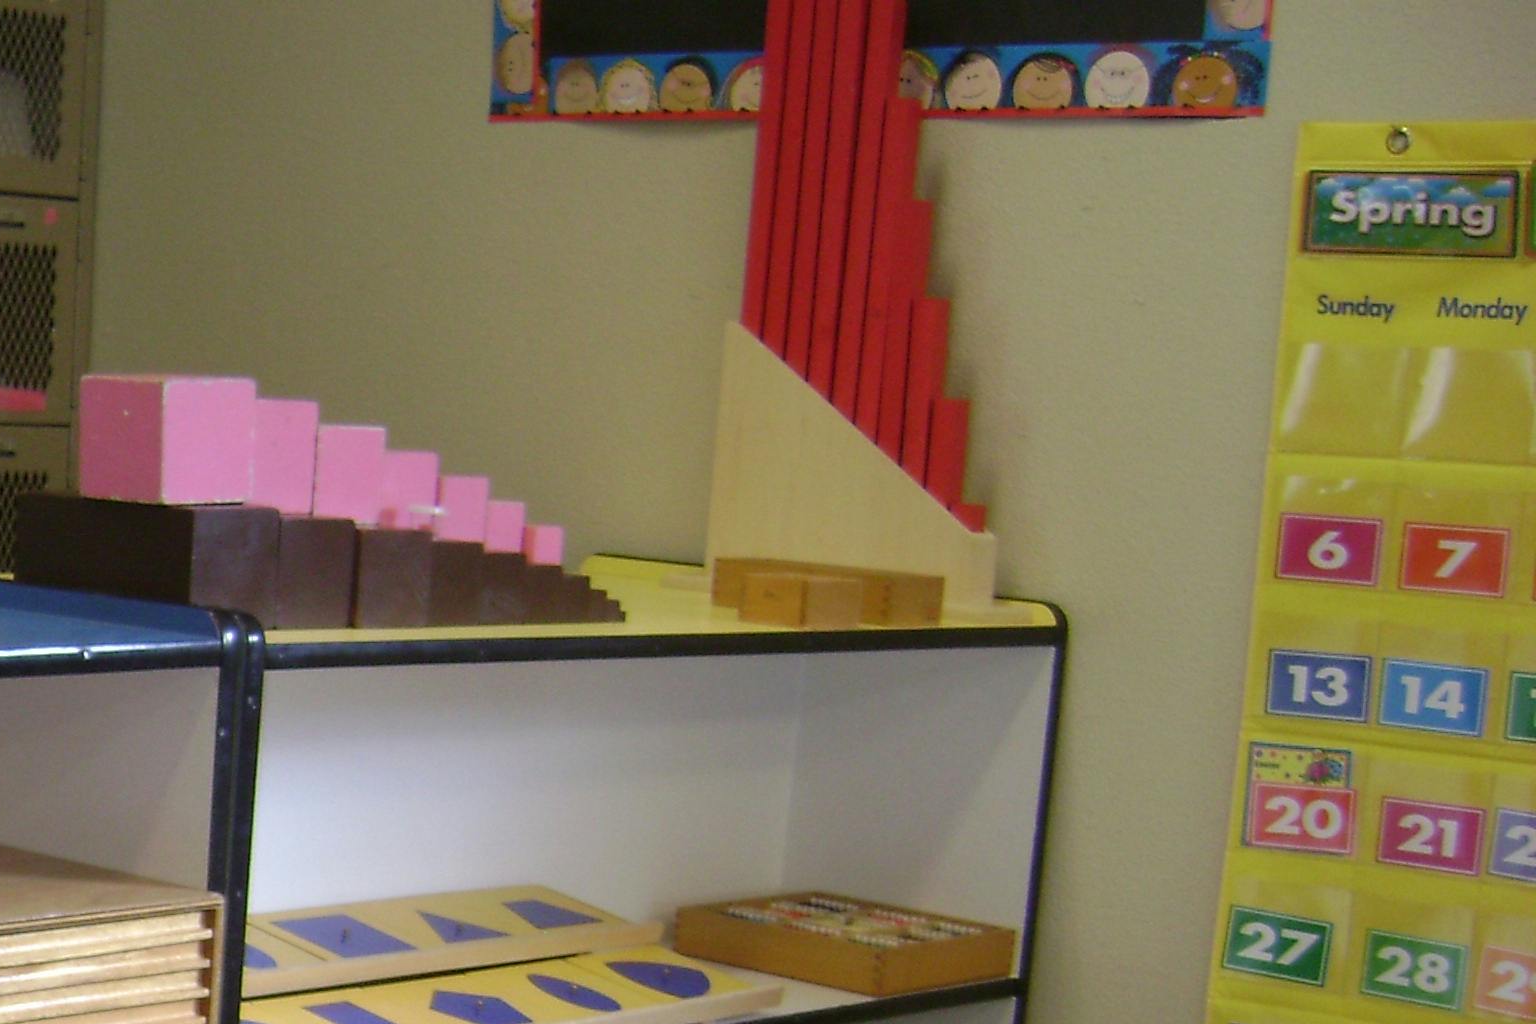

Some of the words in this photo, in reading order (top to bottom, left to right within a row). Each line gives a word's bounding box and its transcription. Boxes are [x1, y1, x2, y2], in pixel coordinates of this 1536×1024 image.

[1329, 190, 1497, 238] Spring
[1317, 294, 1395, 323] Sunday
[1436, 297, 1529, 326] Monday
[1307, 530, 1349, 570] 6
[1434, 539, 1477, 578] 7
[1288, 665, 1350, 707] 13
[1400, 675, 1466, 719] 14
[1264, 796, 1342, 840] 20
[1396, 813, 1460, 858] 21
[1236, 922, 1320, 966] 27
[1375, 946, 1451, 994] 28
[1486, 960, 1536, 1004] 2
